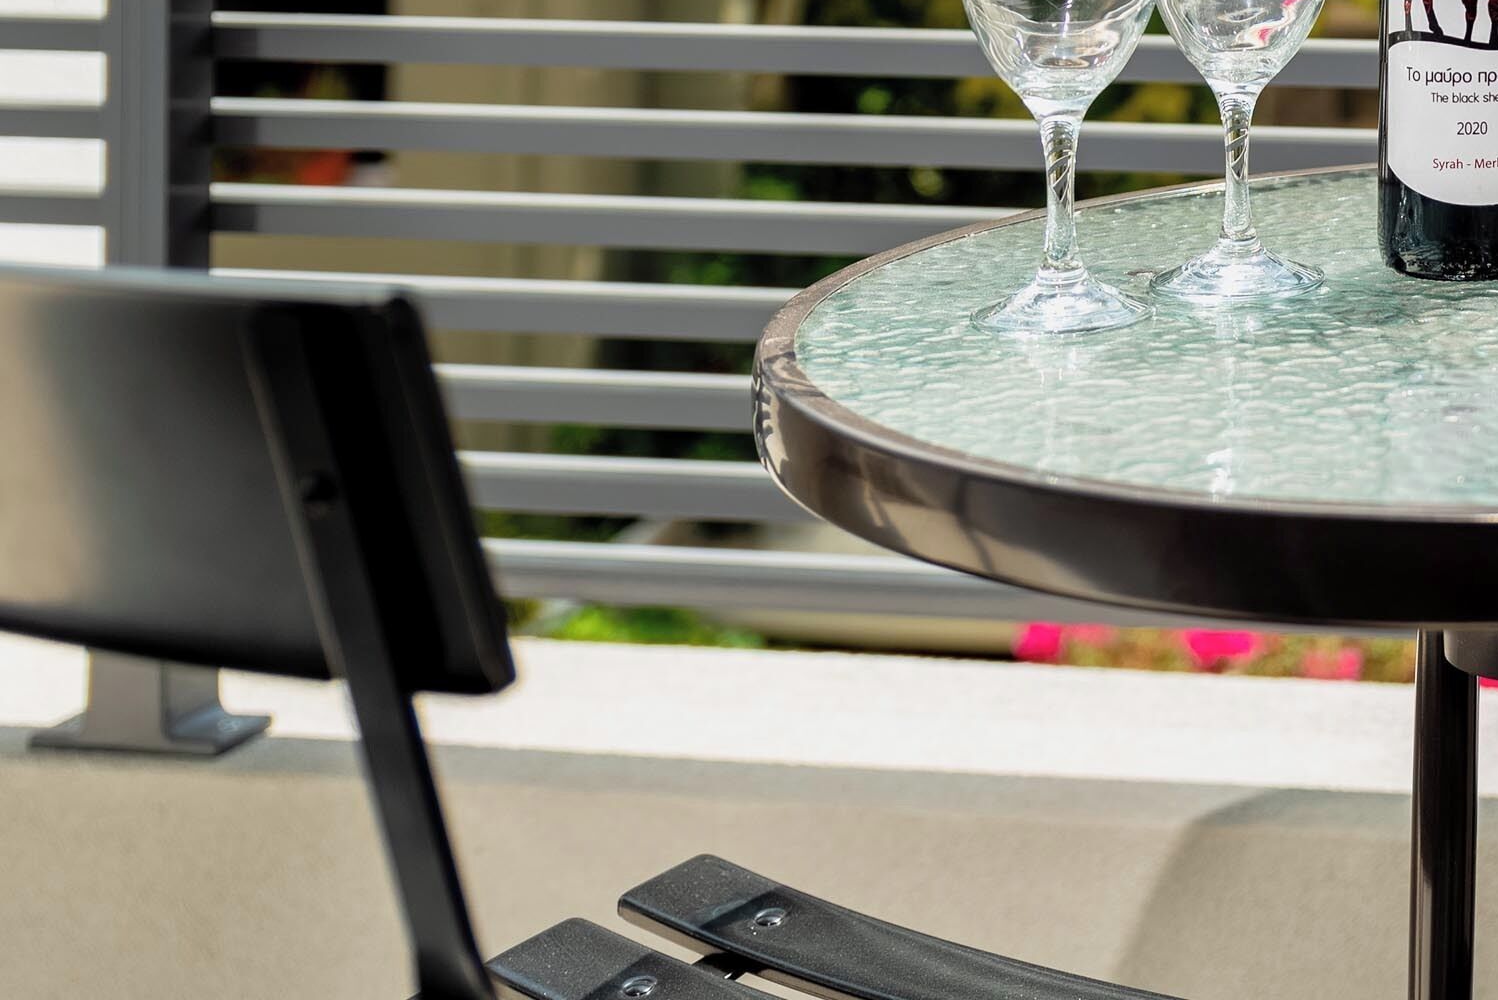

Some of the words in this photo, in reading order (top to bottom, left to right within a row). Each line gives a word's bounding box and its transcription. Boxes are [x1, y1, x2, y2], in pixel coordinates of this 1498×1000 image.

[1425, 67, 1472, 87] μαύρο
[1431, 92, 1449, 103] The
[1452, 92, 1480, 103] black
[1456, 121, 1488, 136] 2020
[1432, 158, 1464, 172] Syrah
